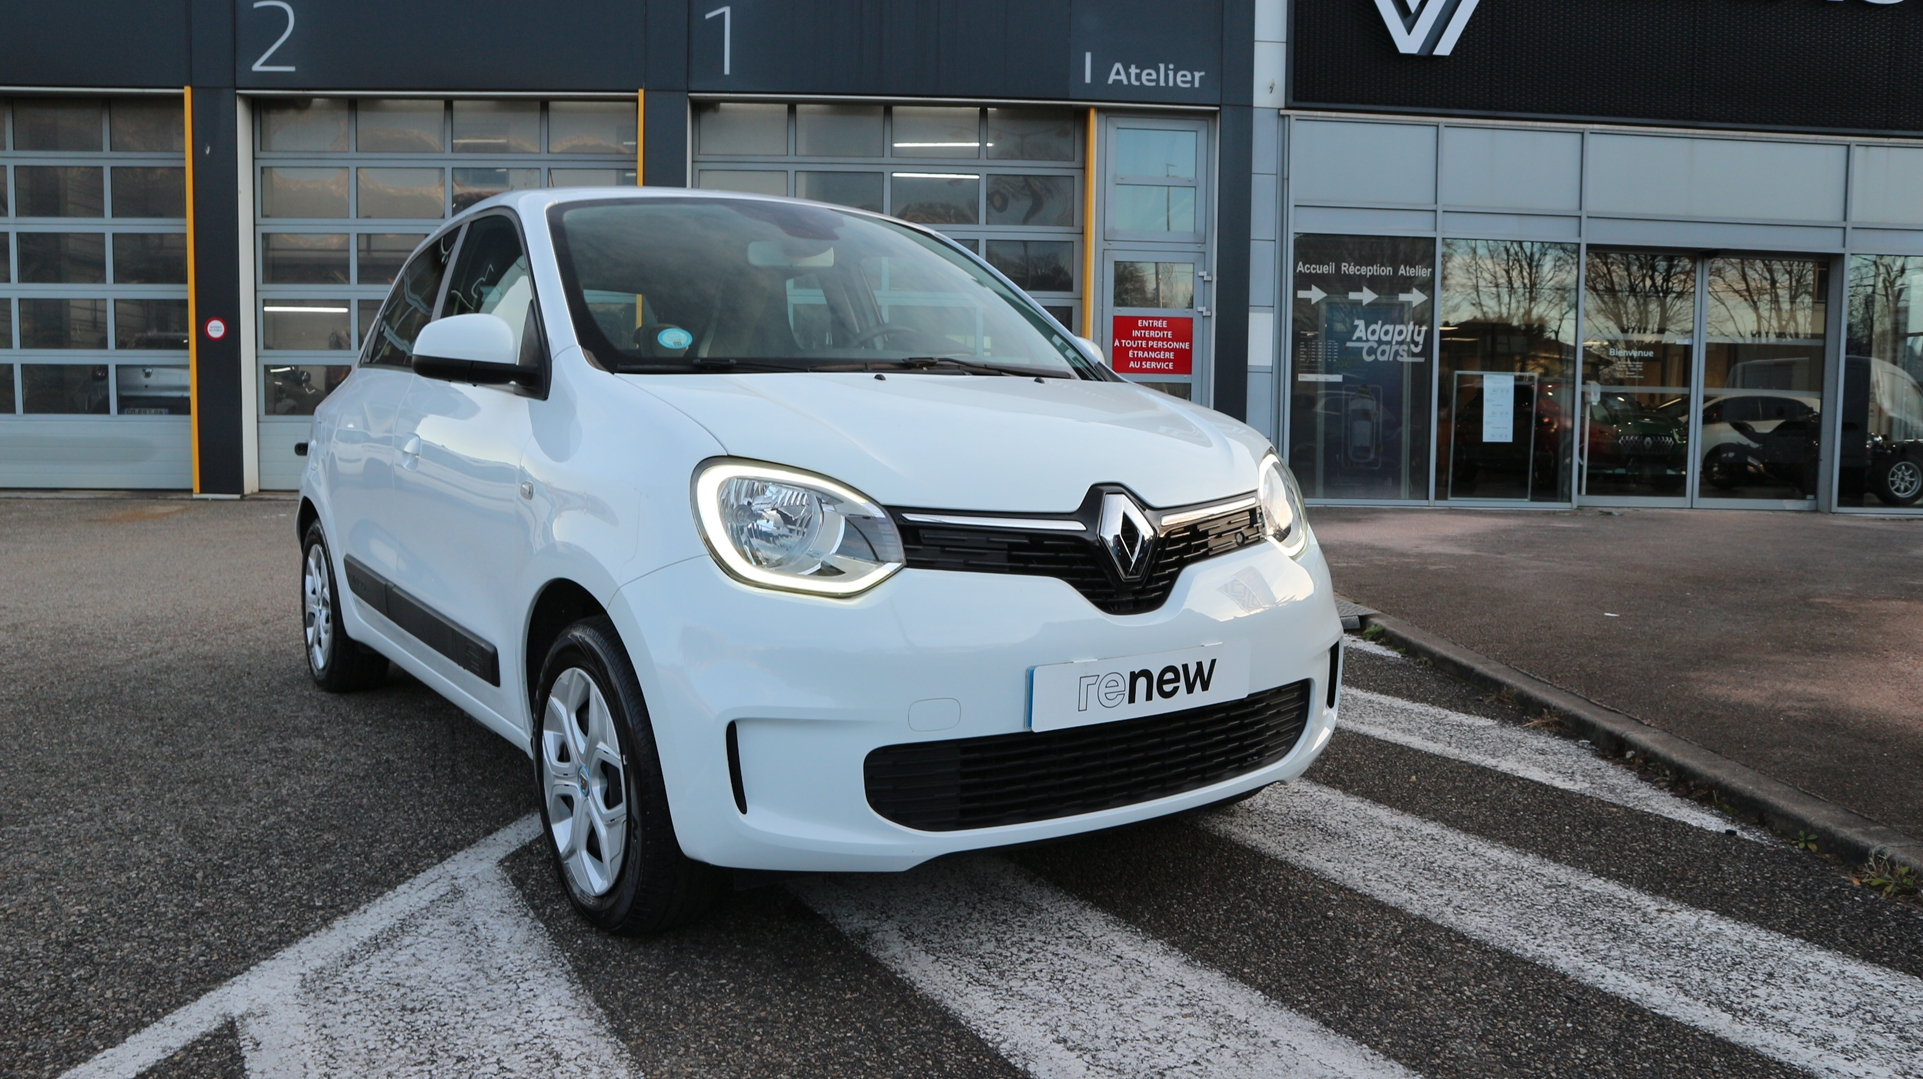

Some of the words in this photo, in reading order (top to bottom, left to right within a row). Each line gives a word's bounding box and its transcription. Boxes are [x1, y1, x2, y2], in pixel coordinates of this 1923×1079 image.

[252, 1, 296, 71] 2
[705, 6, 731, 75] 1
[1107, 62, 1205, 88] Atelier
[1296, 261, 1335, 274] Accueil
[1341, 262, 1393, 278] Réception
[1398, 264, 1432, 277] Atelier
[1138, 319, 1167, 328] ENTRÉE
[1132, 330, 1172, 338] INTERDITE
[1352, 320, 1426, 353] Adapty
[1114, 339, 1119, 347] À
[1121, 340, 1146, 348] TOUTE
[1148, 341, 1190, 349] PERSONNE
[1346, 341, 1425, 362] Cars
[1609, 348, 1654, 357] Bienvenue
[1129, 349, 1174, 359] ÉTRANGÈRE
[1142, 361, 1174, 369] SERVICE
[1078, 658, 1217, 712] renew
